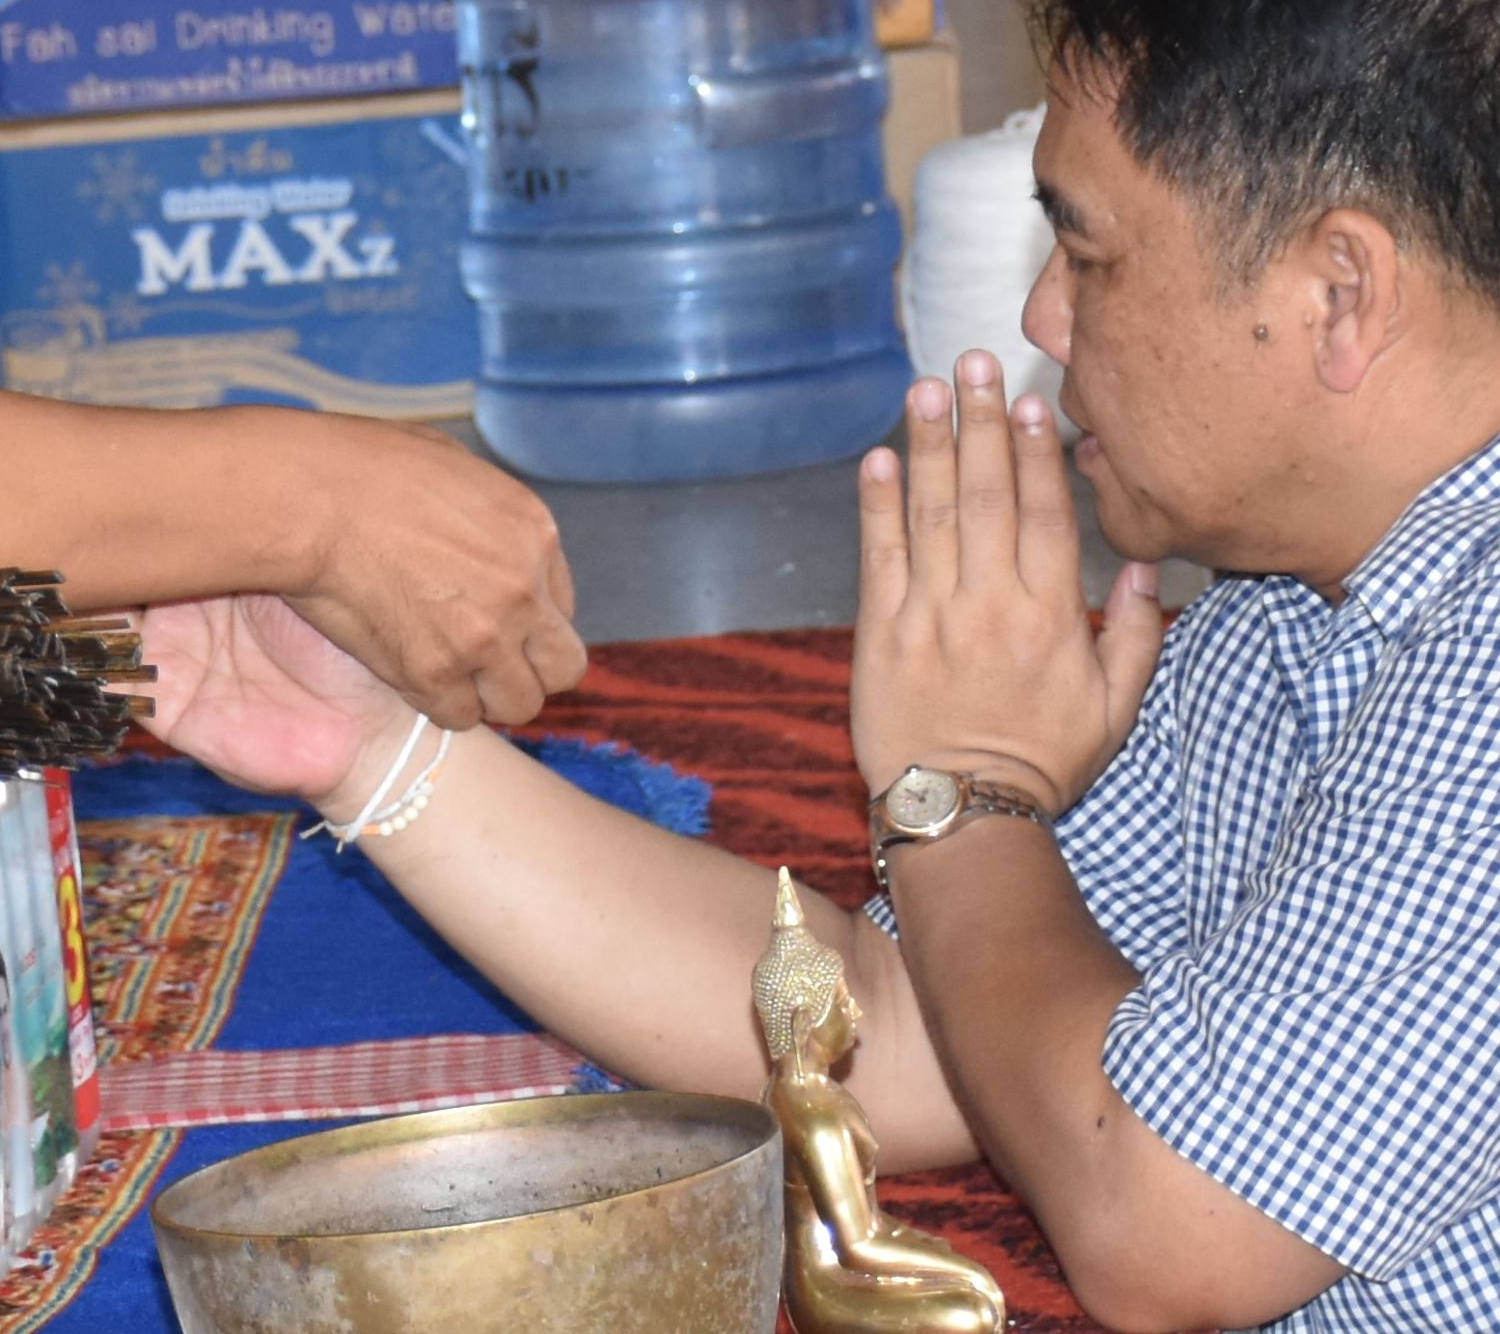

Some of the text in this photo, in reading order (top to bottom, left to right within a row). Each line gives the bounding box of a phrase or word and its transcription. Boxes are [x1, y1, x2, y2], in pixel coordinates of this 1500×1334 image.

[1, 21, 78, 64] Fah
[175, 8, 336, 57] Drinking
[352, 0, 457, 37] Wate
